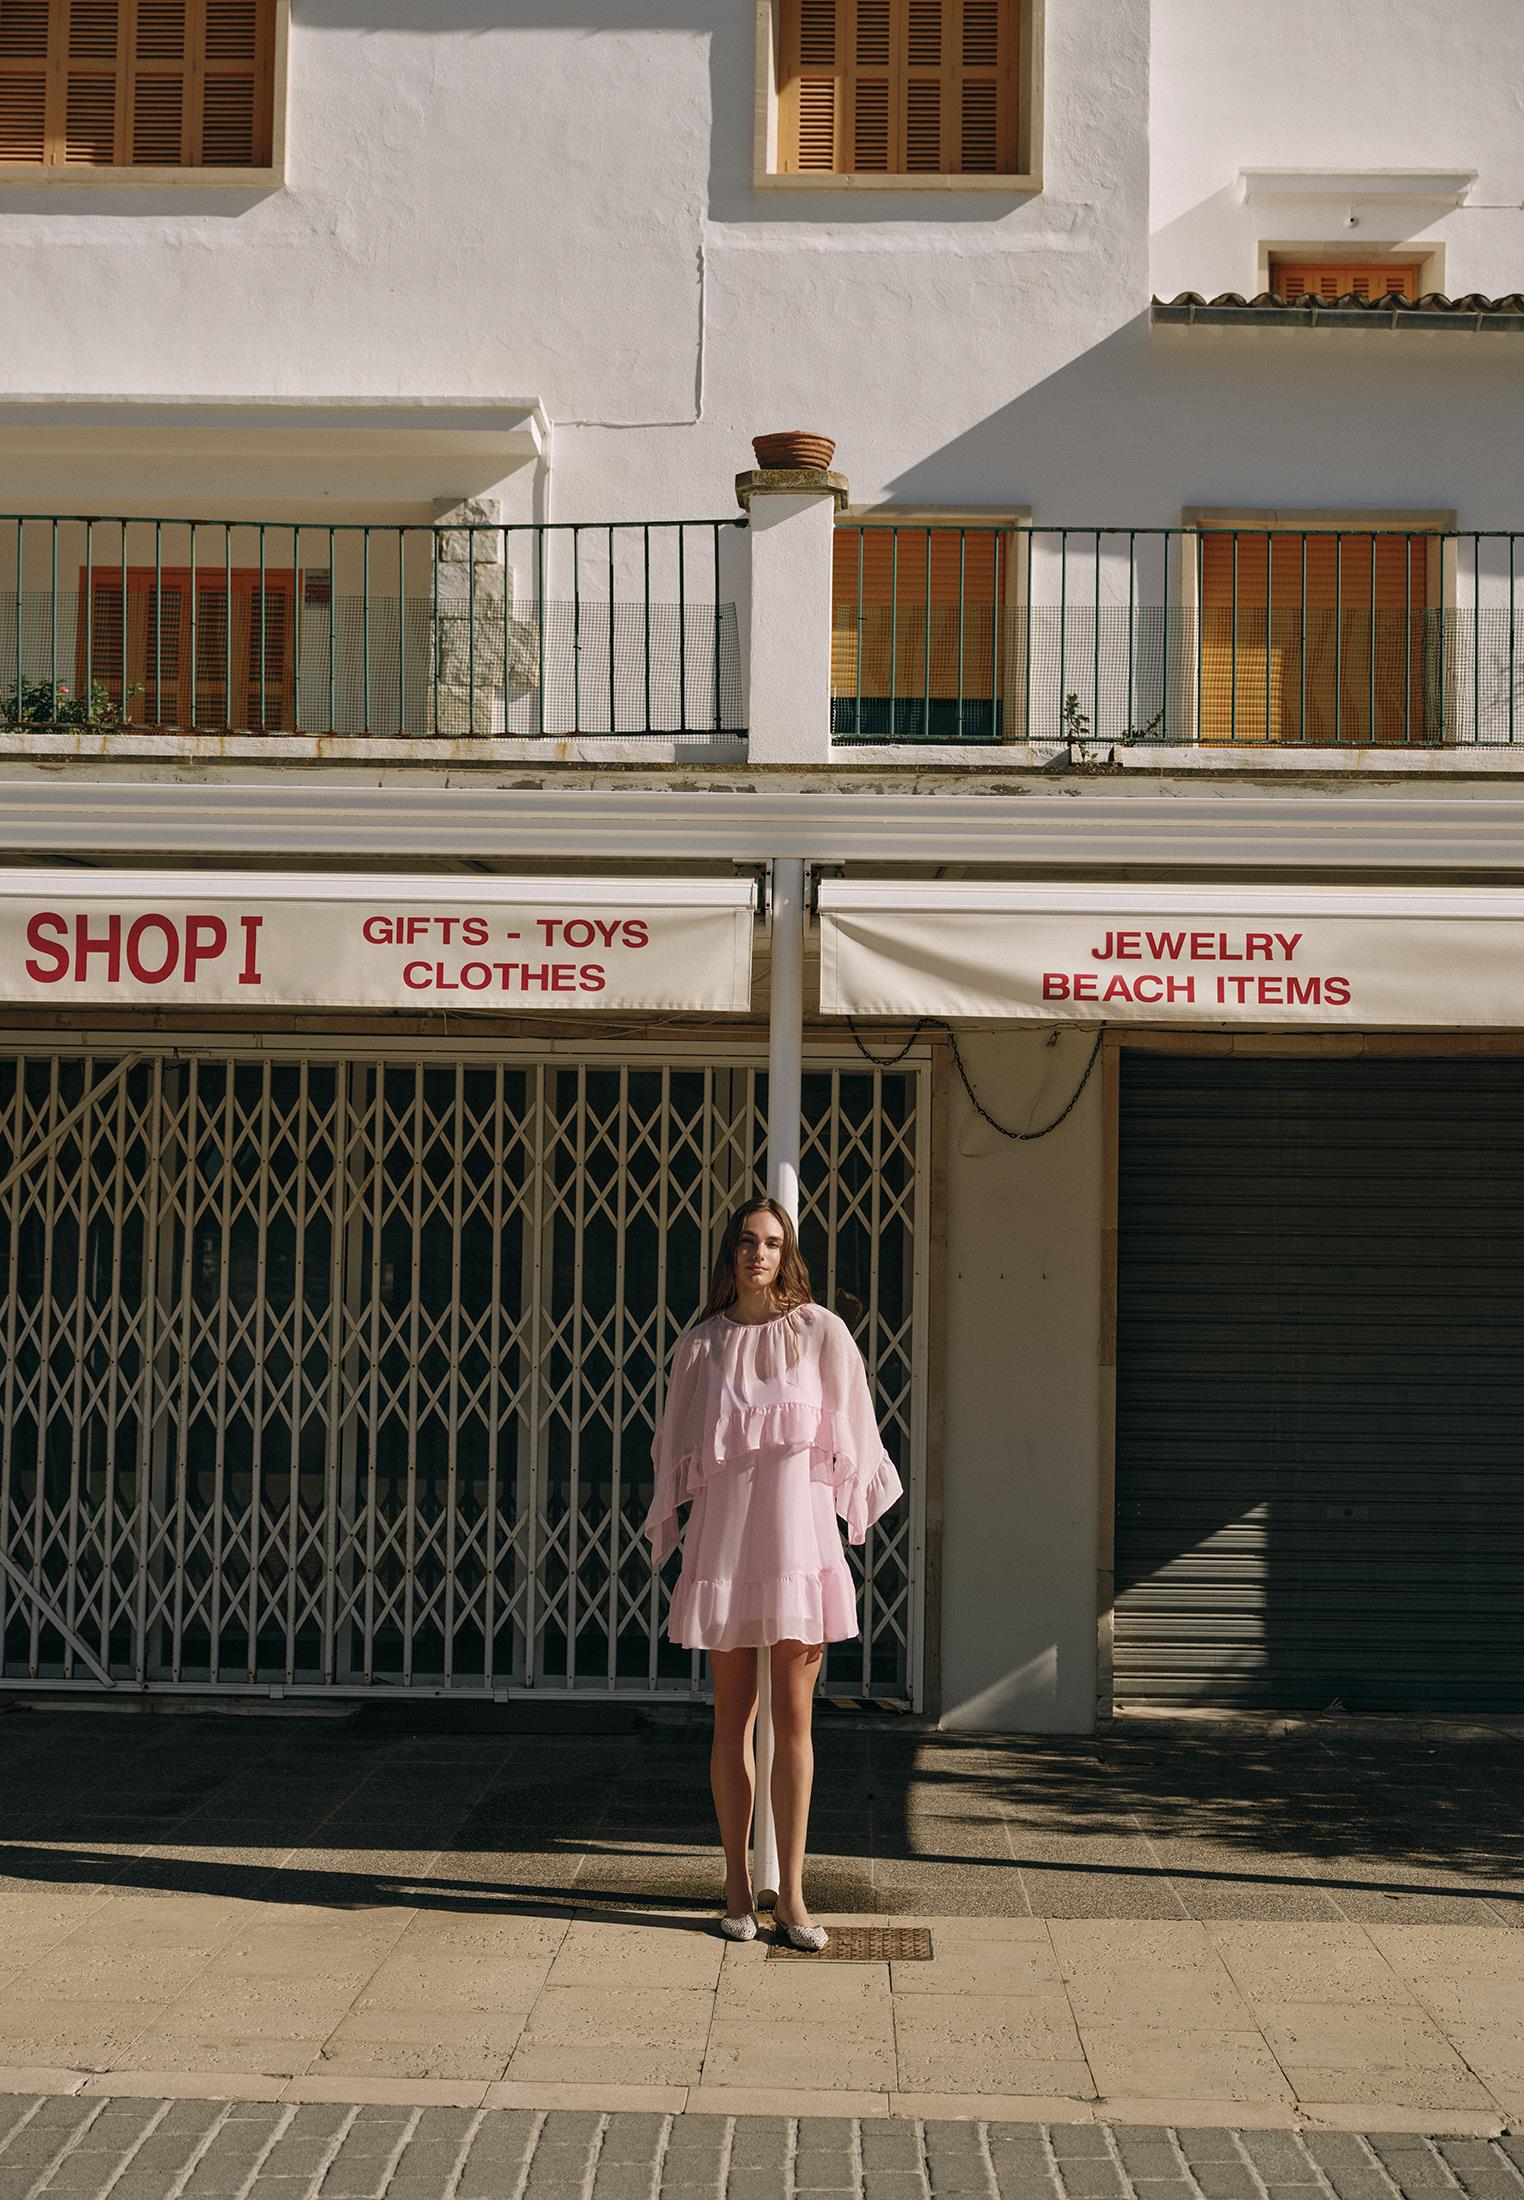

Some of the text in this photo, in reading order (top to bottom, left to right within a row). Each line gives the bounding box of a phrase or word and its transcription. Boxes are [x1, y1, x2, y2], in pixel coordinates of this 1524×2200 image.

[363, 915, 489, 946] GIFTS
[537, 919, 649, 949] TOYS
[1091, 930, 1302, 961] JEWELRY
[402, 961, 606, 992] CLOTHES
[1041, 972, 1350, 1006] BEACH ITEMS
